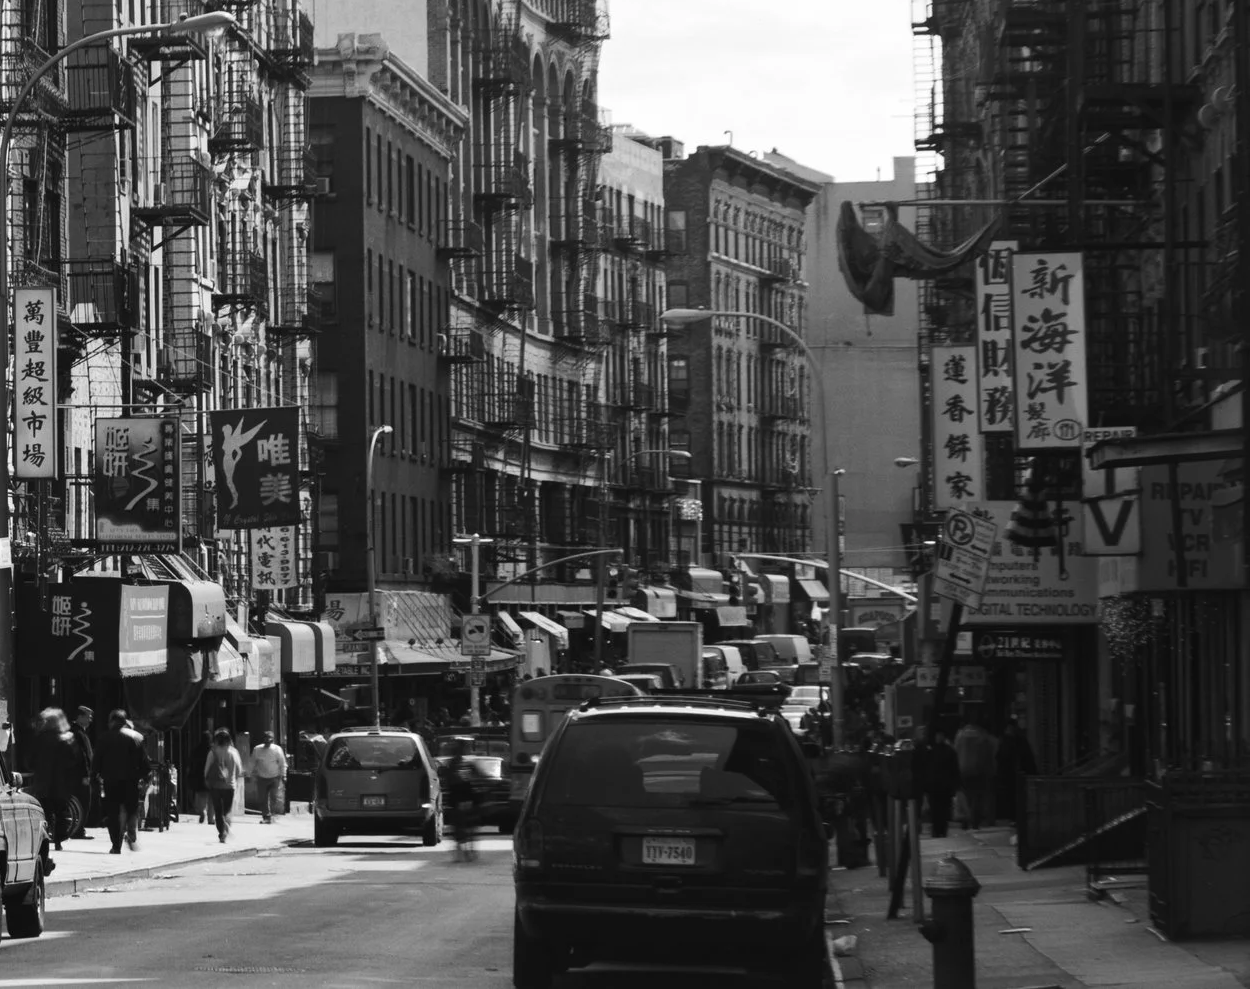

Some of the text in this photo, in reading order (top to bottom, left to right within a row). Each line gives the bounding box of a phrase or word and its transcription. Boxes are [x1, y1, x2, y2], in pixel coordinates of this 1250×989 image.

[20, 299, 50, 468] 萬豐超級市場
[1020, 258, 1080, 405] 新海洋
[256, 431, 293, 507] 唯美
[941, 354, 976, 500] 蓮香餅家
[1016, 602, 1098, 617] TECHNOLOGY
